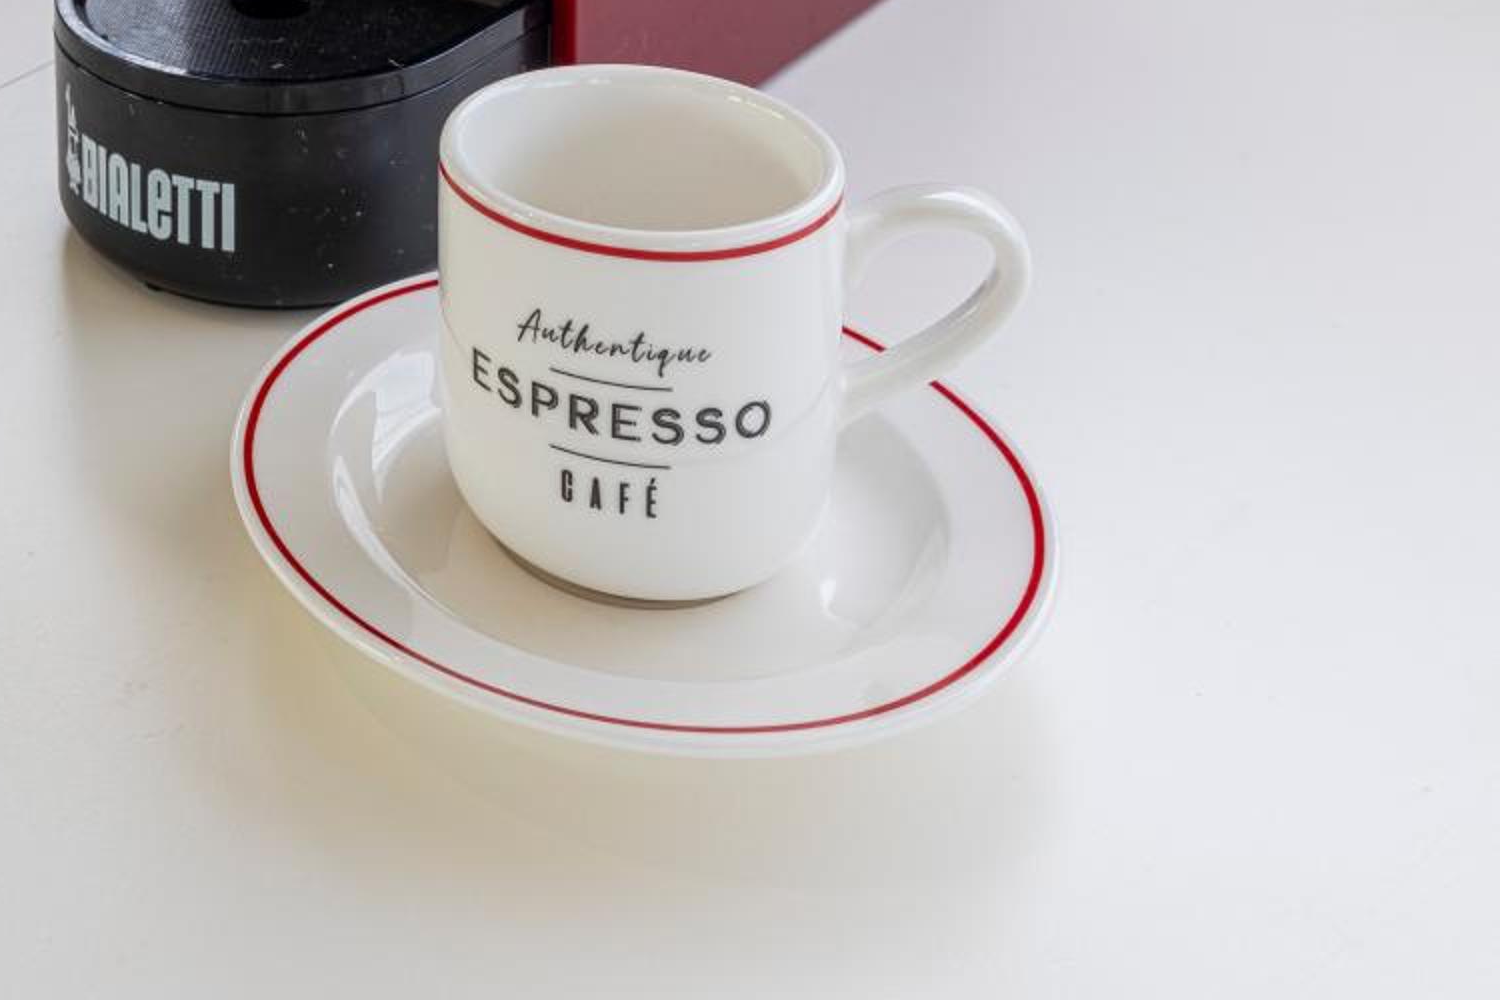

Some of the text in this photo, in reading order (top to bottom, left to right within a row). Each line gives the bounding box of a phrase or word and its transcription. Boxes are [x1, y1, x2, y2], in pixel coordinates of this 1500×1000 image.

[517, 308, 712, 378] Authentique
[472, 346, 772, 446] ESPRESSO
[560, 468, 660, 519] CAFÉ
